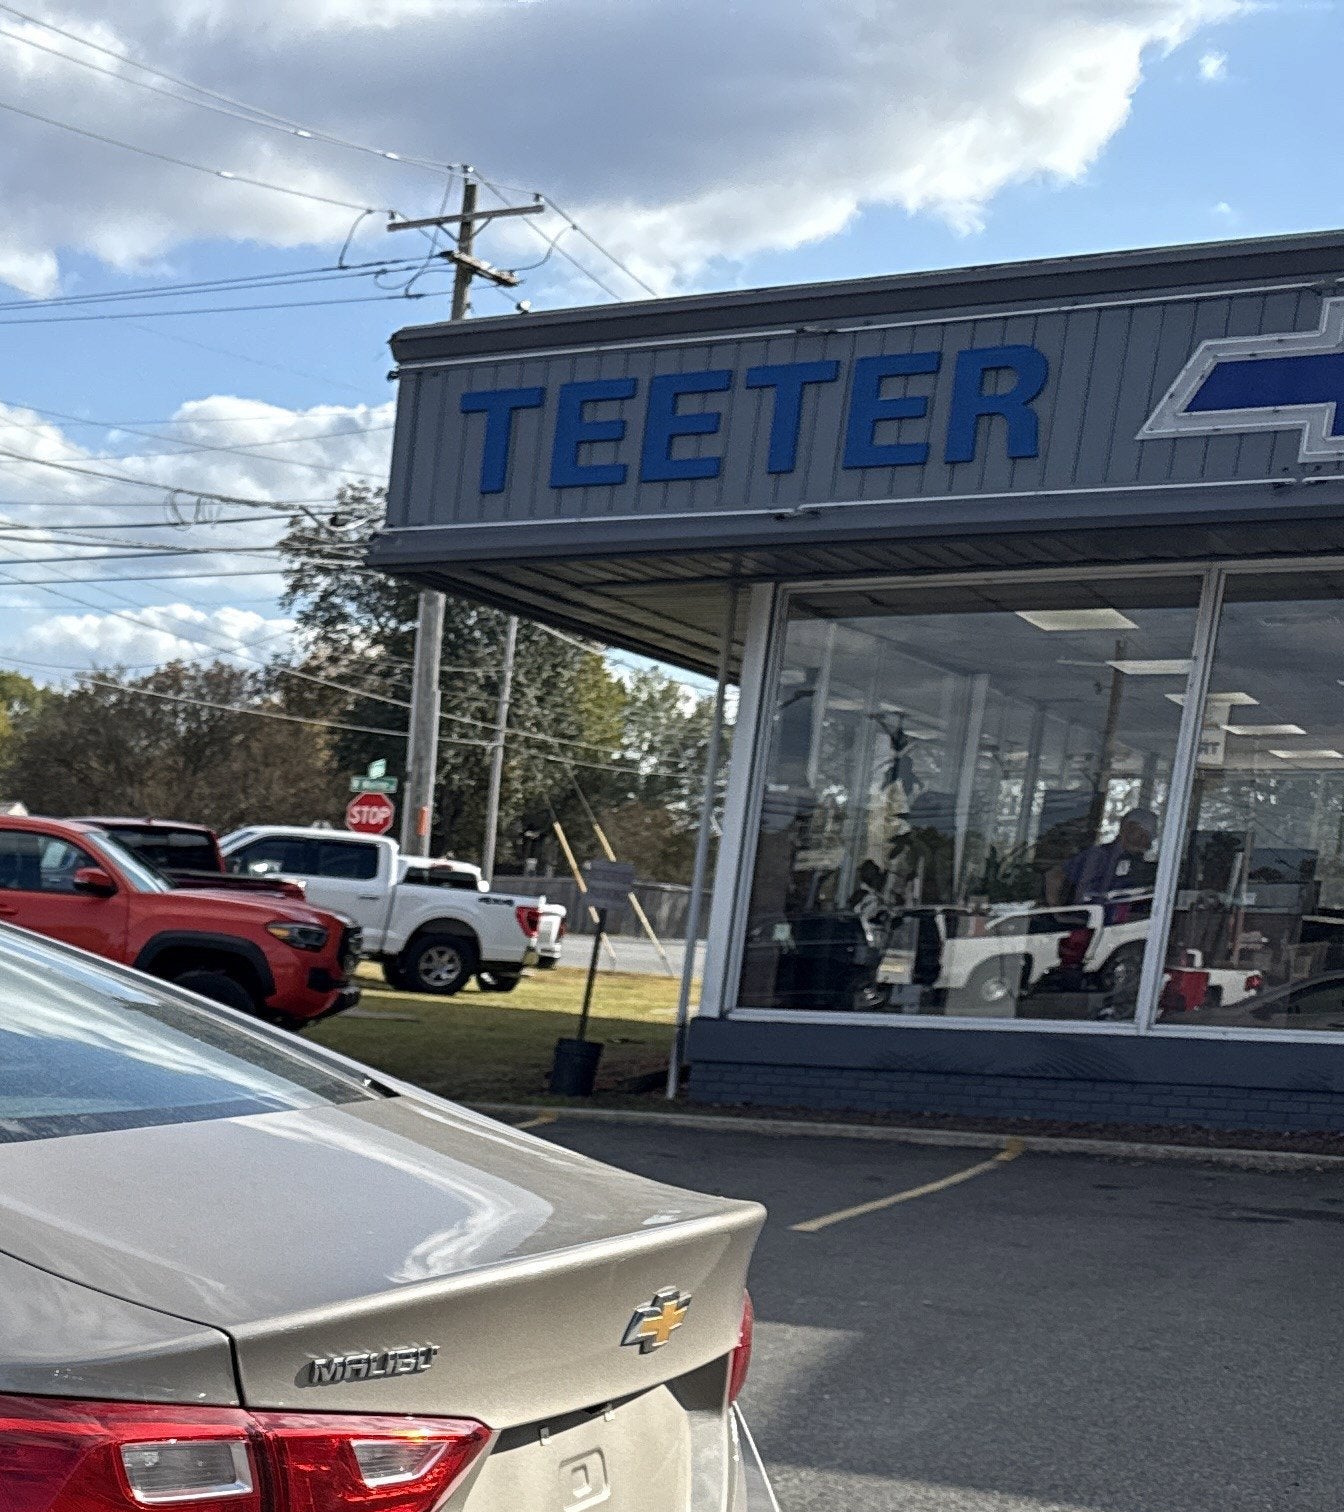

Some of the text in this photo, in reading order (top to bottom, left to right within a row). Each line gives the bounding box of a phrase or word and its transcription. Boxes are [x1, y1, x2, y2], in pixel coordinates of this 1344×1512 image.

[459, 343, 1050, 495] TEETER
[350, 805, 391, 825] STOP
[308, 1345, 441, 1384] MALIBU
